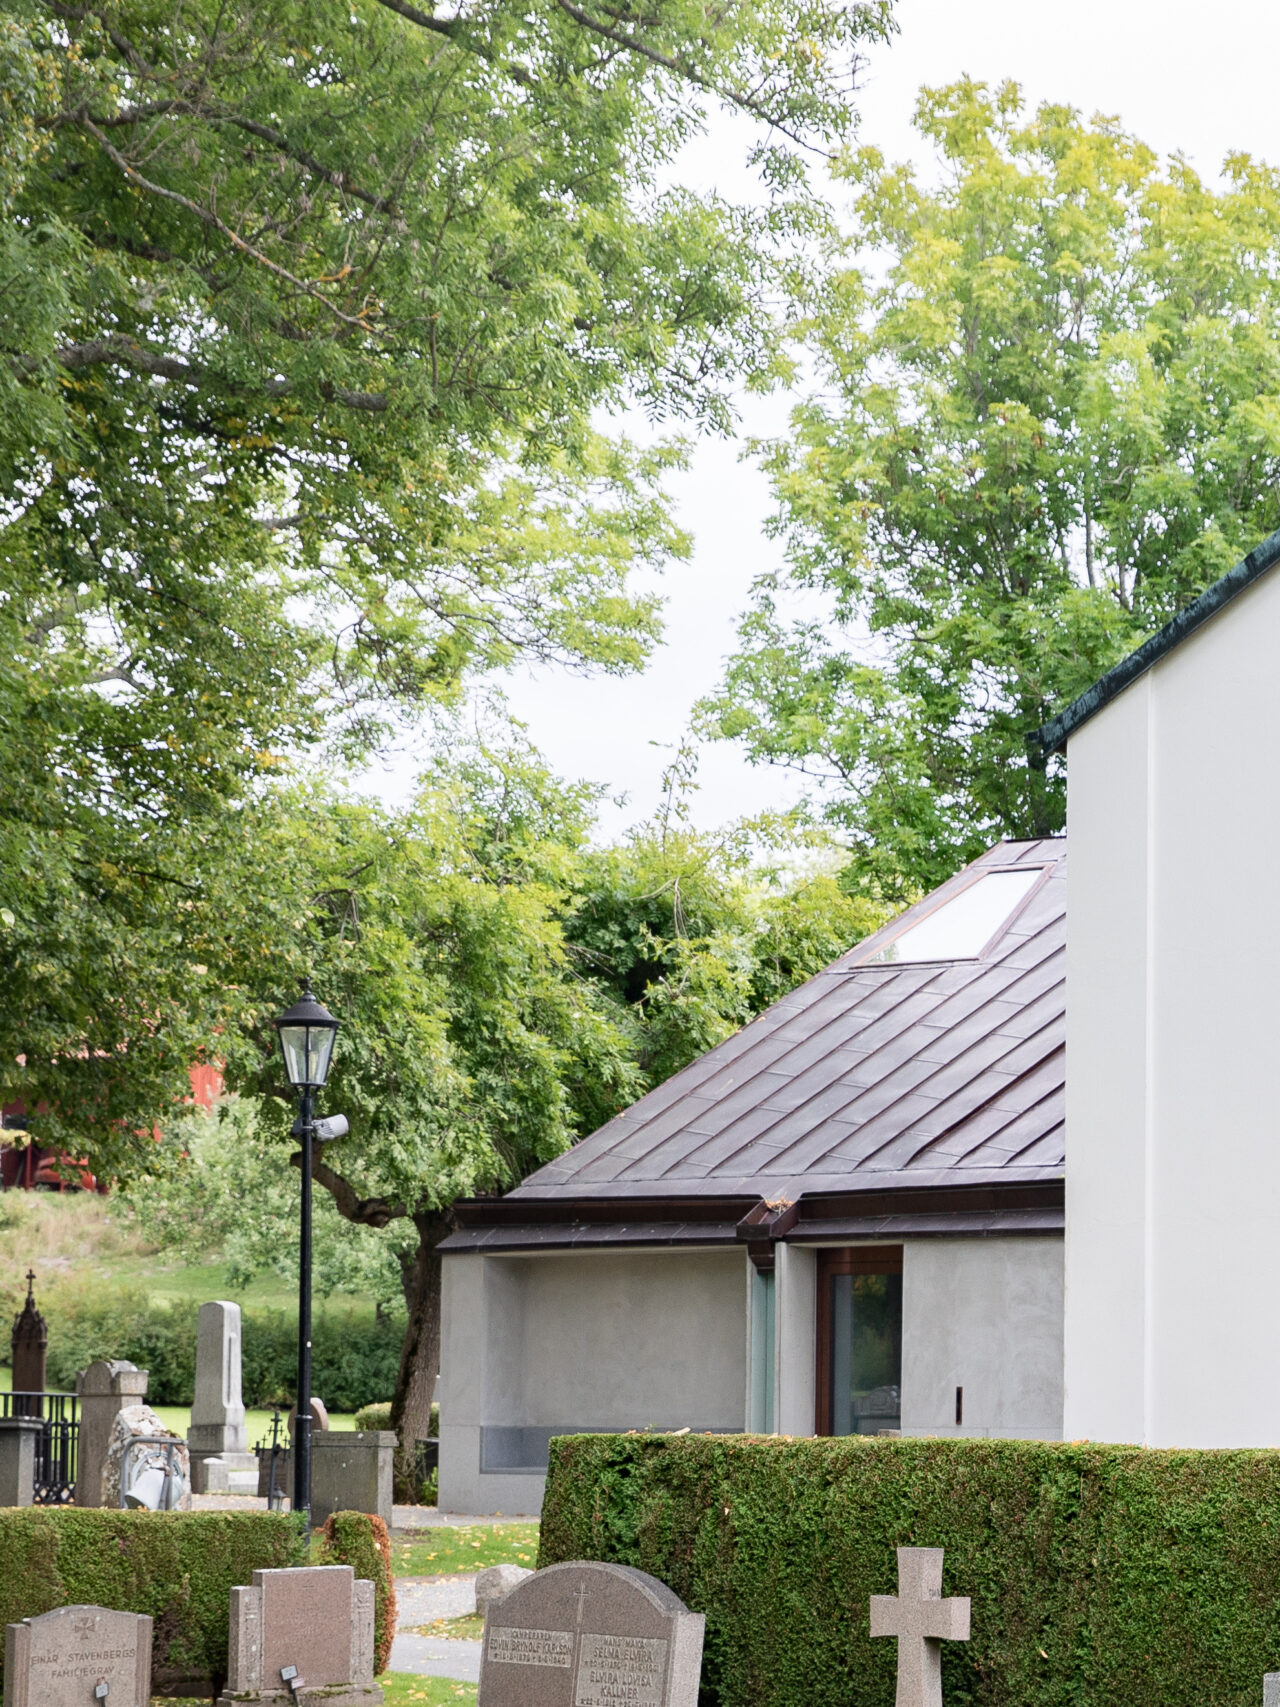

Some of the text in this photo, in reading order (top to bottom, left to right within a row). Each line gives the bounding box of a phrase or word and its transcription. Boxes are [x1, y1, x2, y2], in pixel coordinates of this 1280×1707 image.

[31, 1648, 136, 1665] EINAR STAVENBERGS
[593, 1647, 653, 1662] SELMA ELVIRA
[590, 1671, 652, 1687] ELVIRA LOVISA
